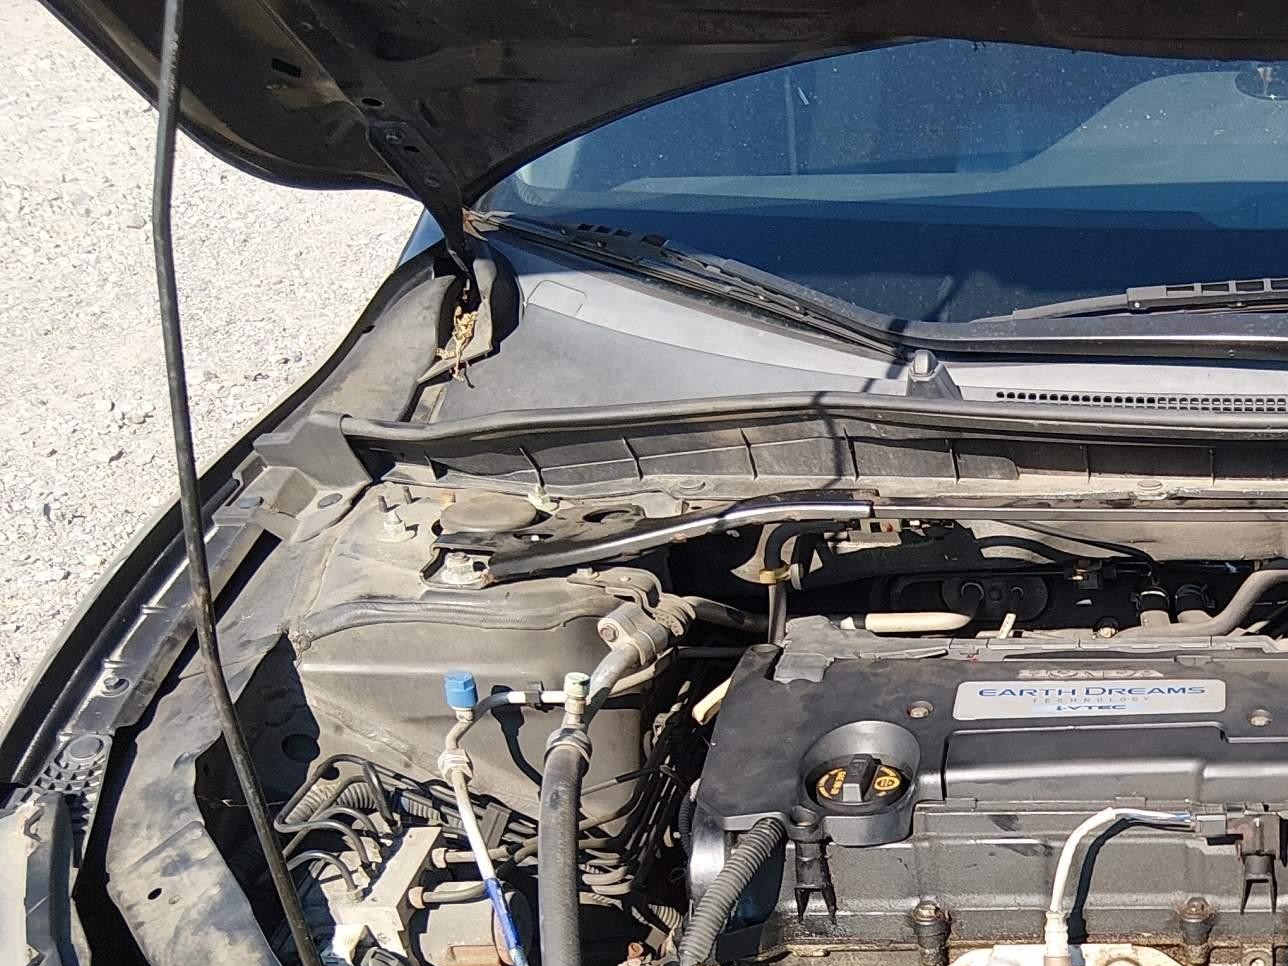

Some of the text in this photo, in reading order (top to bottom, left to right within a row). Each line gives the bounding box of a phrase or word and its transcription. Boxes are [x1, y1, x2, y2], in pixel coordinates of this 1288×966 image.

[1016, 669, 1165, 679] HONDA
[977, 686, 1206, 698] EARTH DREAMS
[1032, 696, 1150, 704] TECHNOLOGY
